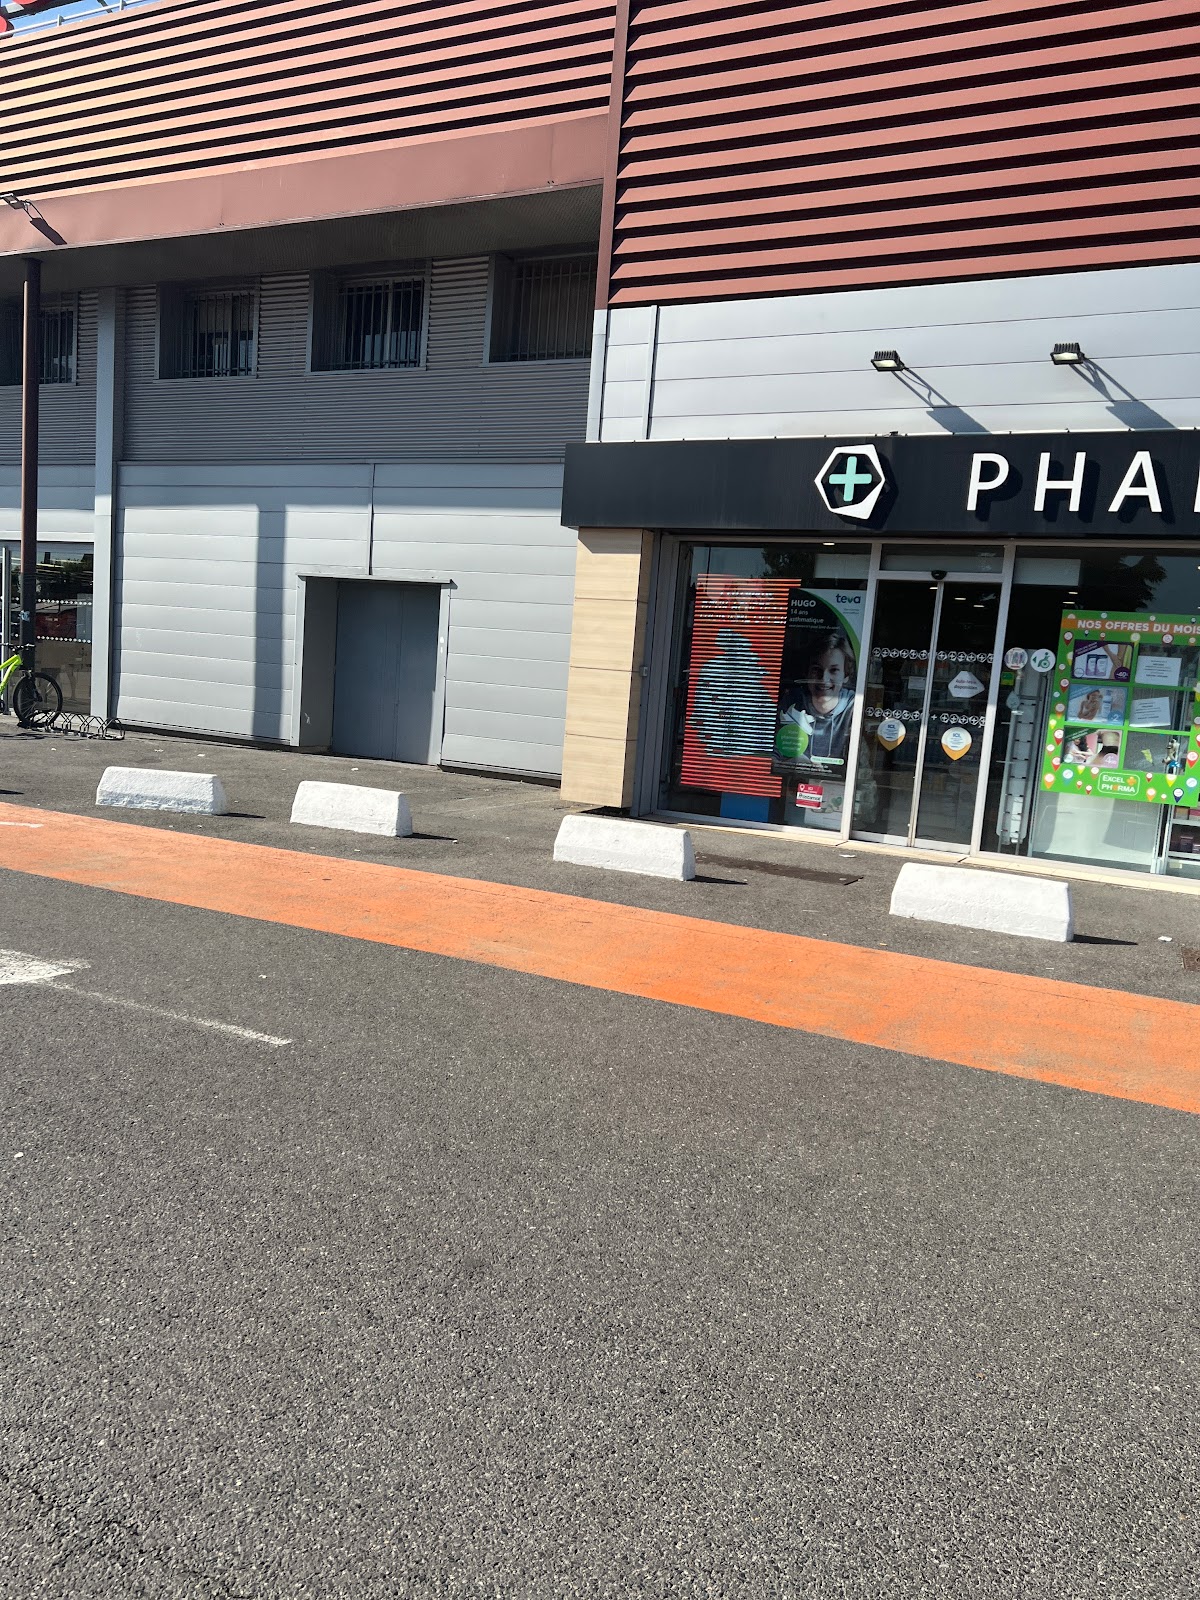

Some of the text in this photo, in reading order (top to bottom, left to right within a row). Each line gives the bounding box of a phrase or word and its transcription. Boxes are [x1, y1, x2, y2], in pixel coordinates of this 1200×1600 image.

[966, 450, 1200, 513] PHA
[790, 600, 817, 608] HUGO
[836, 593, 861, 604] teva
[1077, 619, 1102, 629] NOS
[1105, 621, 1149, 632] OFFRES
[1153, 623, 1170, 633] DU
